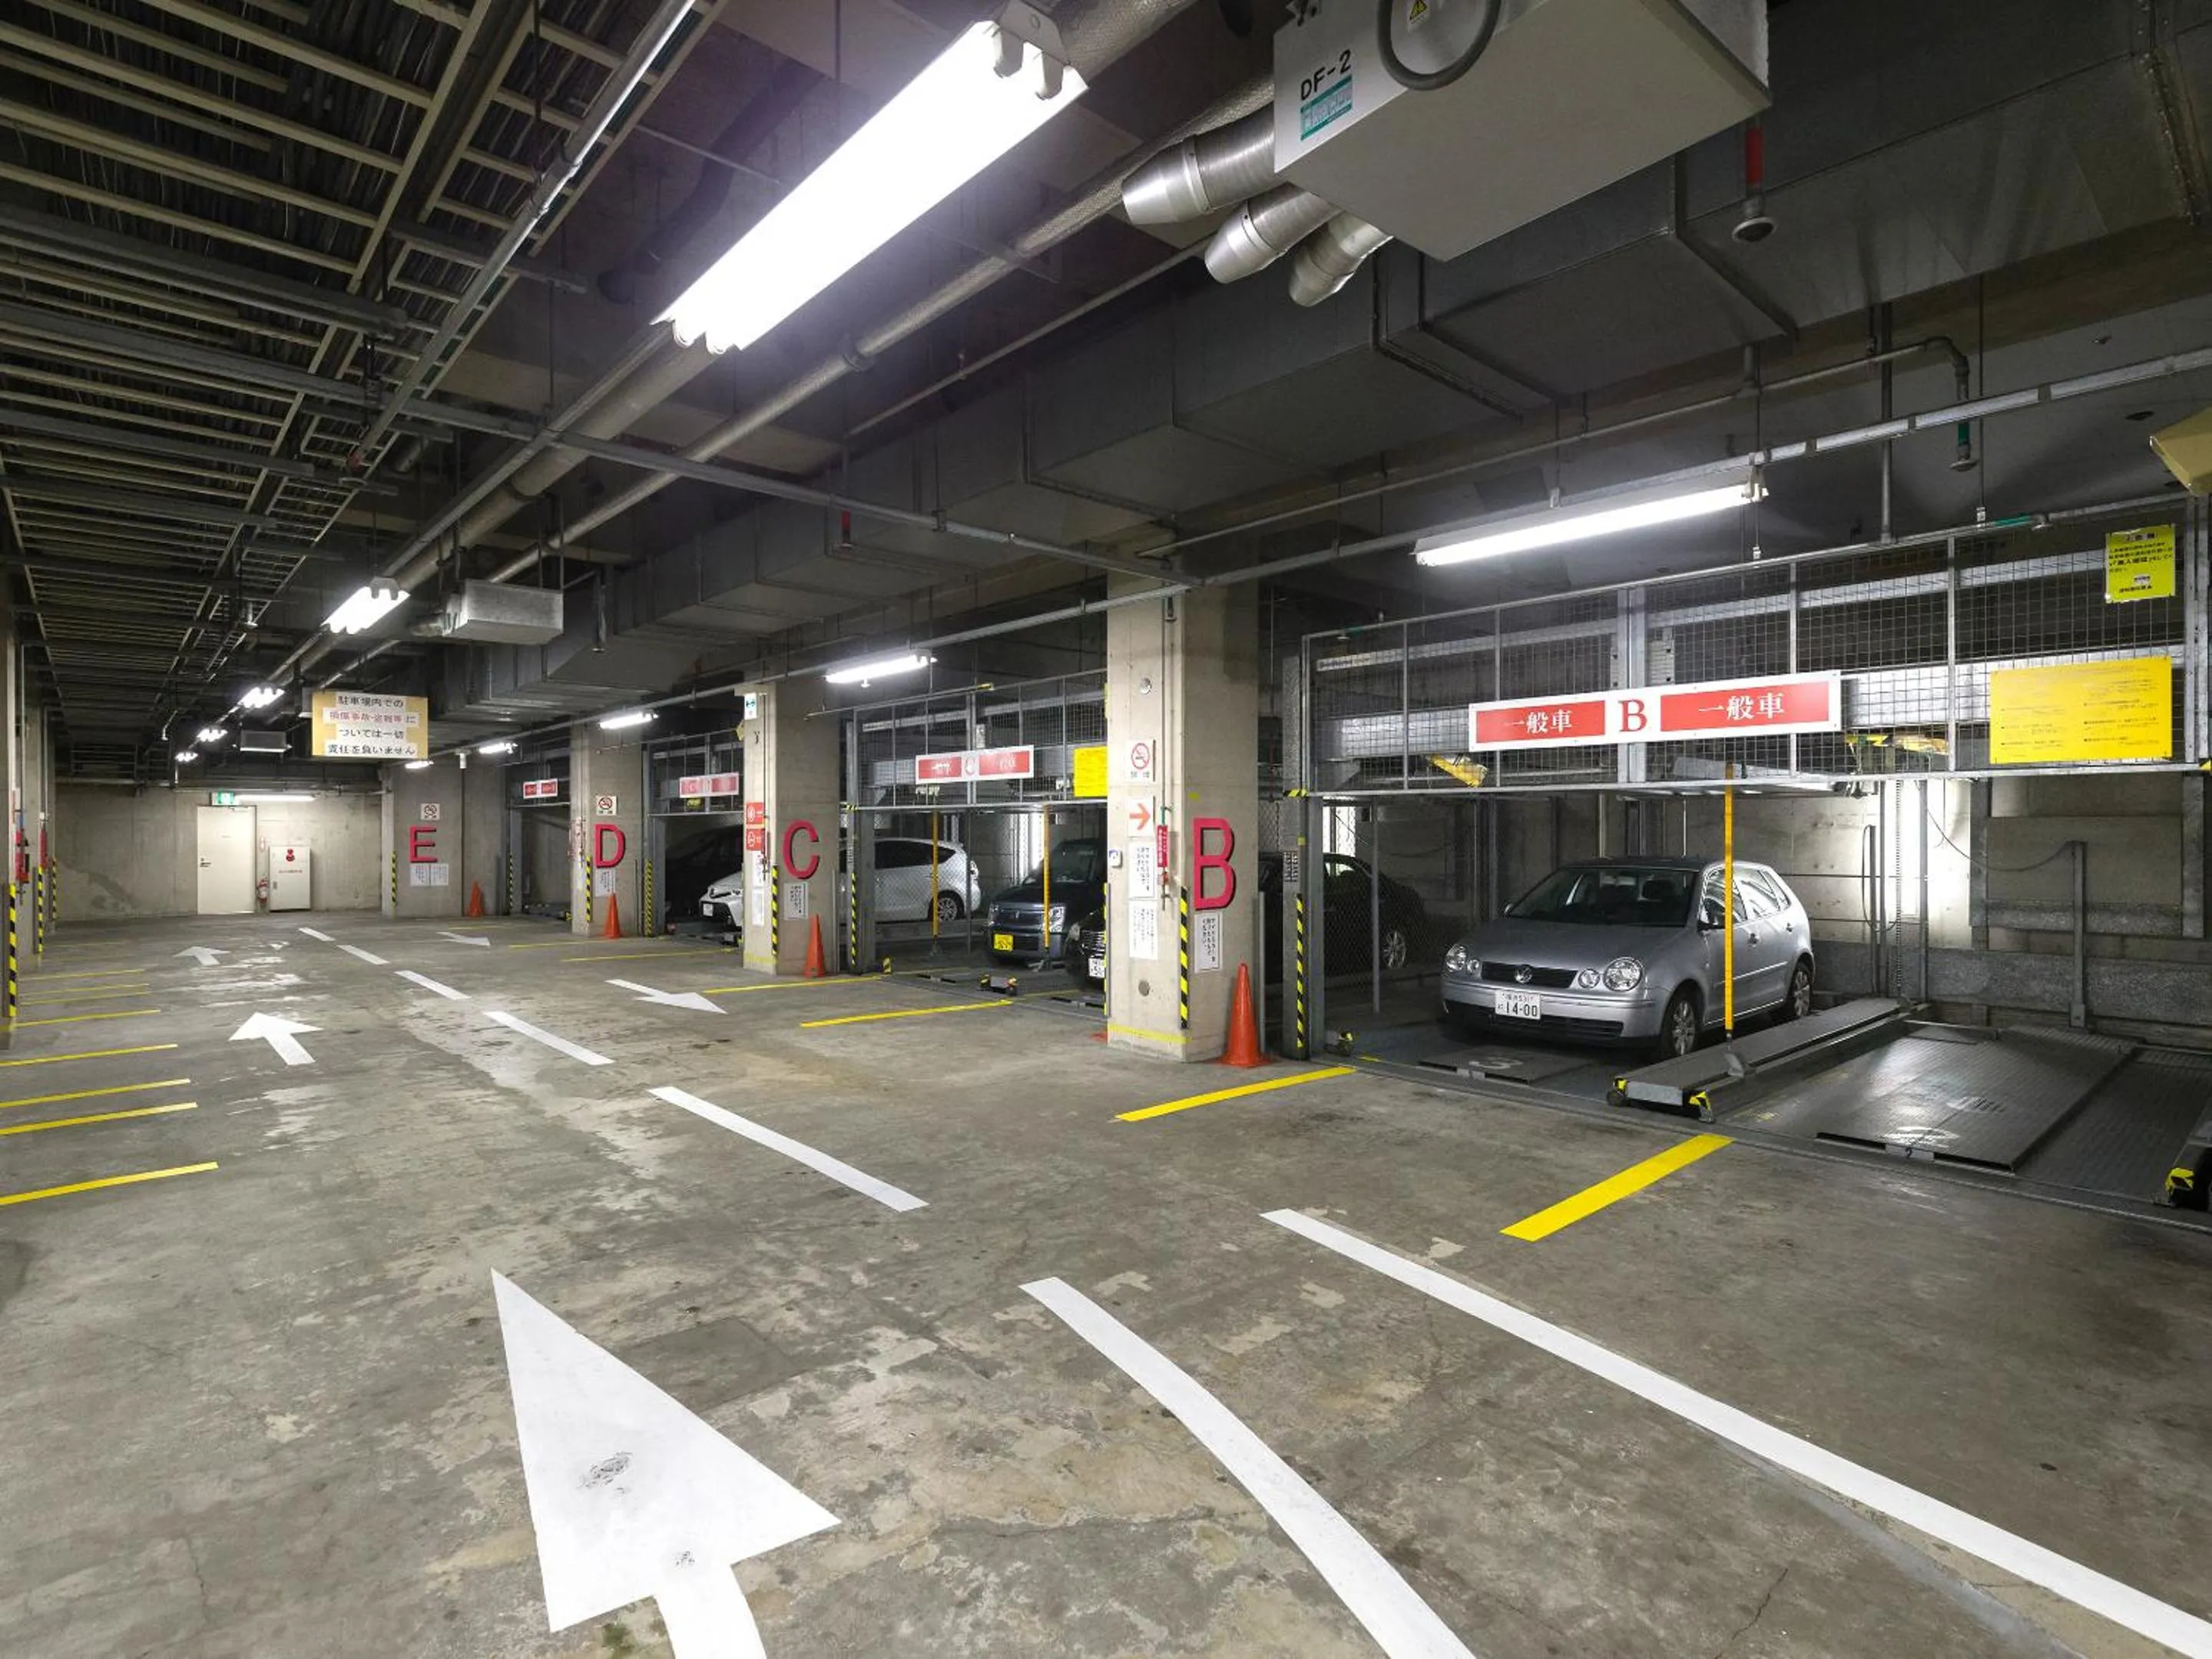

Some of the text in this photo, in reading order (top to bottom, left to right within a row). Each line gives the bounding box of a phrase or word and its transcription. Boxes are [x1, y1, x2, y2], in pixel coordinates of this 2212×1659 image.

[1300, 49, 1351, 101] DF-2
[337, 695, 403, 707] 駐車場内での
[1505, 693, 1785, 733] 一般車 B 一般車
[328, 743, 415, 755] 責任を負いません
[339, 729, 404, 740] ついては一切
[409, 824, 437, 863] E
[594, 823, 626, 869] D
[782, 819, 820, 879] C
[1193, 817, 1236, 911] B
[1506, 1002, 1537, 1016] 14-00
